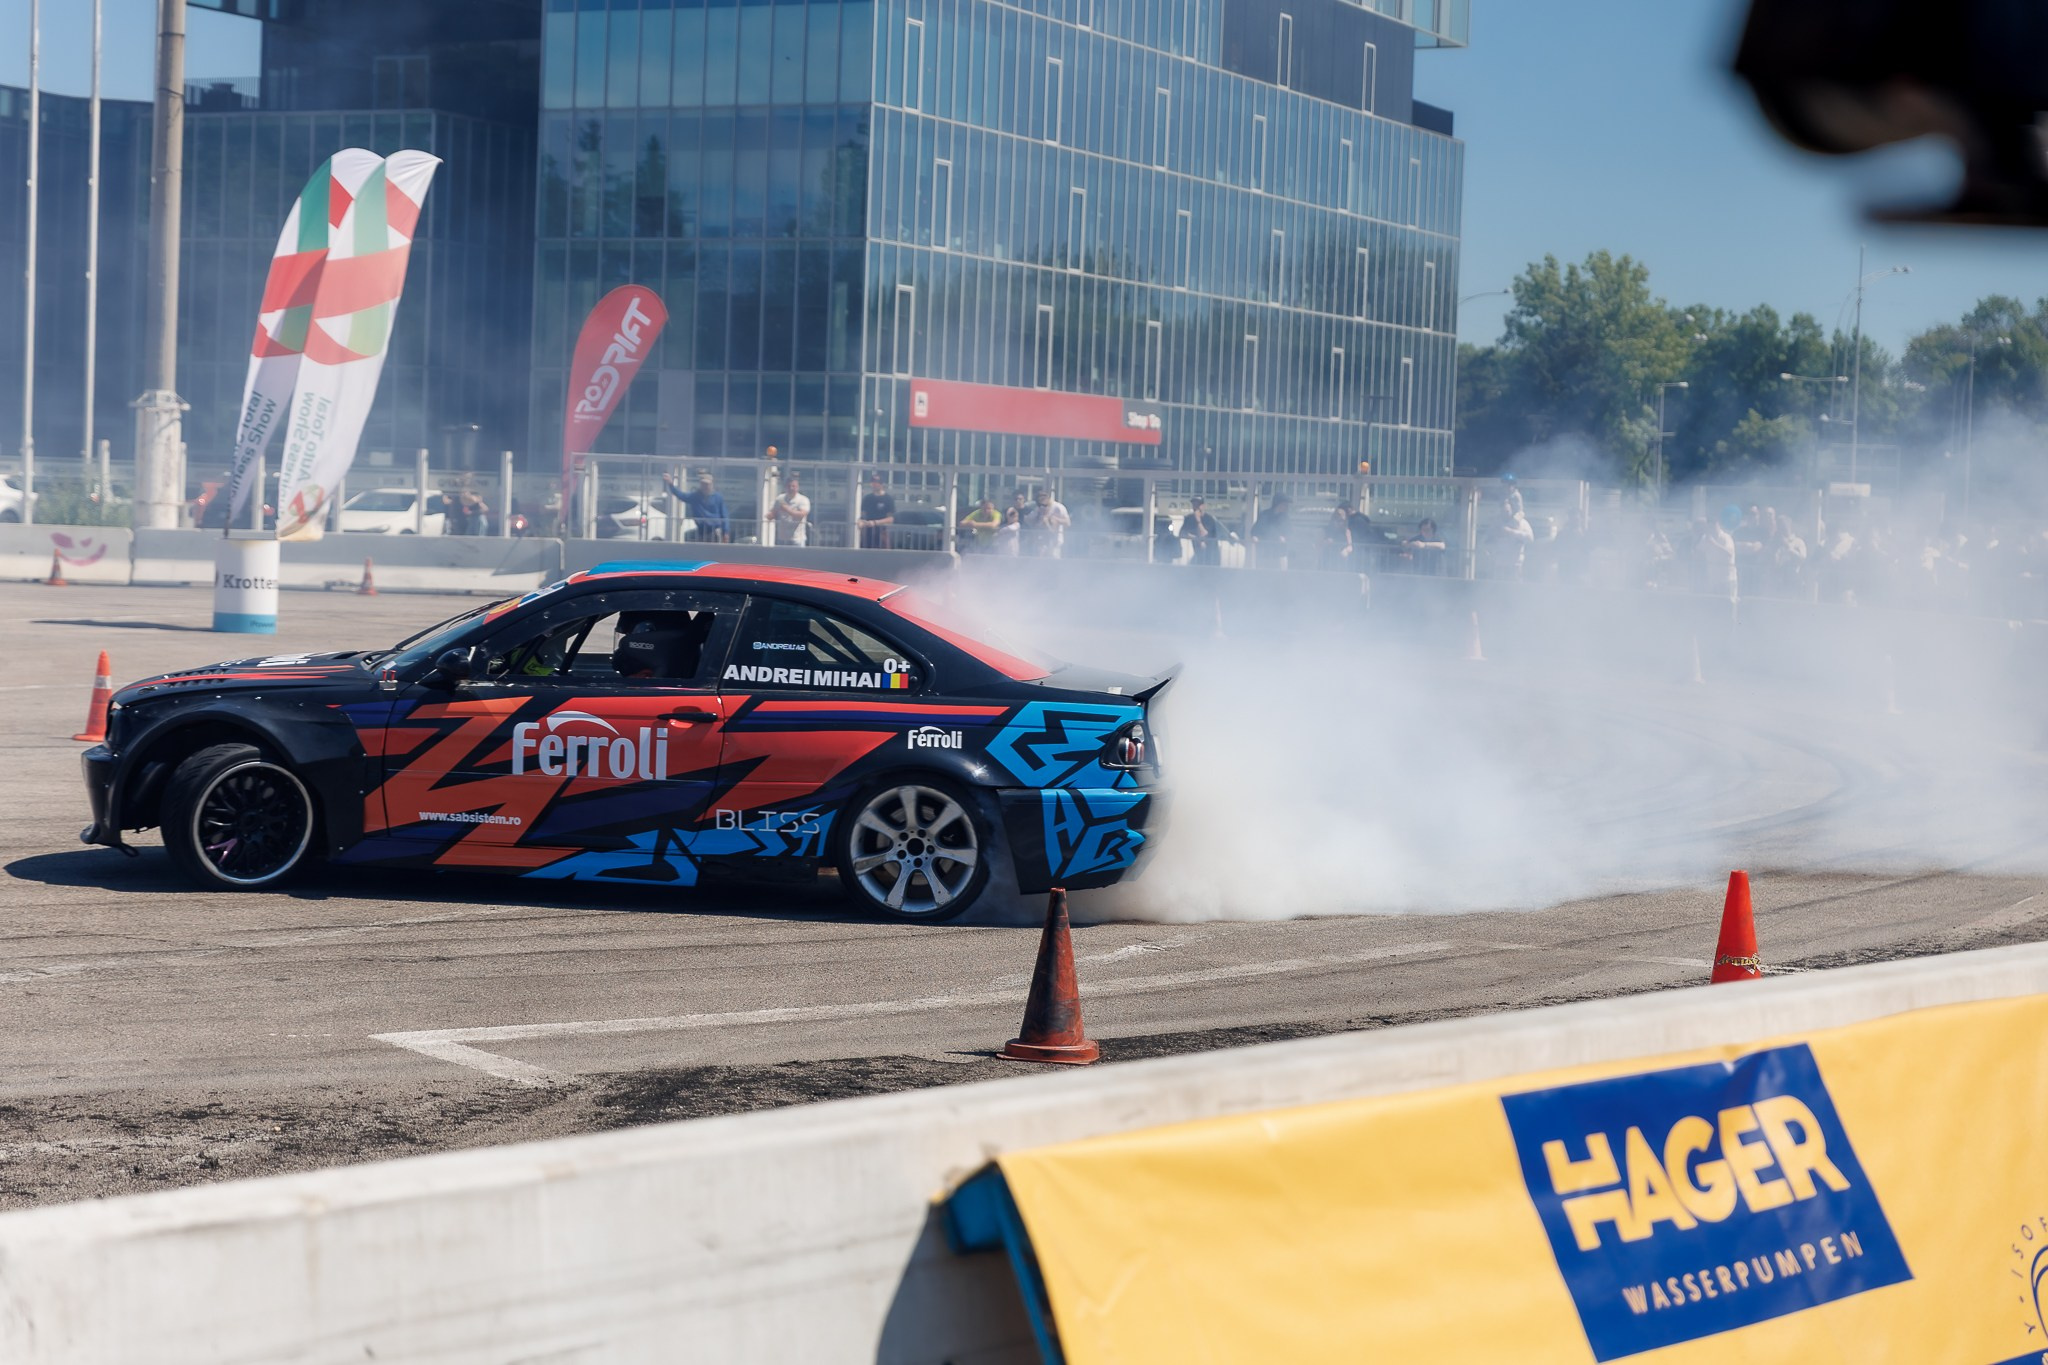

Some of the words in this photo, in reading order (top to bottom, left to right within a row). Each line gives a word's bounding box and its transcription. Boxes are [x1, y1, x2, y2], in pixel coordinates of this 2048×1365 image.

[247, 398, 277, 446] Show
[222, 573, 279, 590] Krotte
[723, 664, 811, 685] ANDREI
[813, 669, 881, 688] MIHAI
[512, 712, 669, 781] Ferroli
[907, 727, 963, 750] Ferroli
[418, 811, 522, 826] www.sabsistem.ro
[715, 808, 821, 835] BLISS
[1541, 1095, 1851, 1252] HAGER
[1621, 1231, 1864, 1315] WASSERPUMPEN
